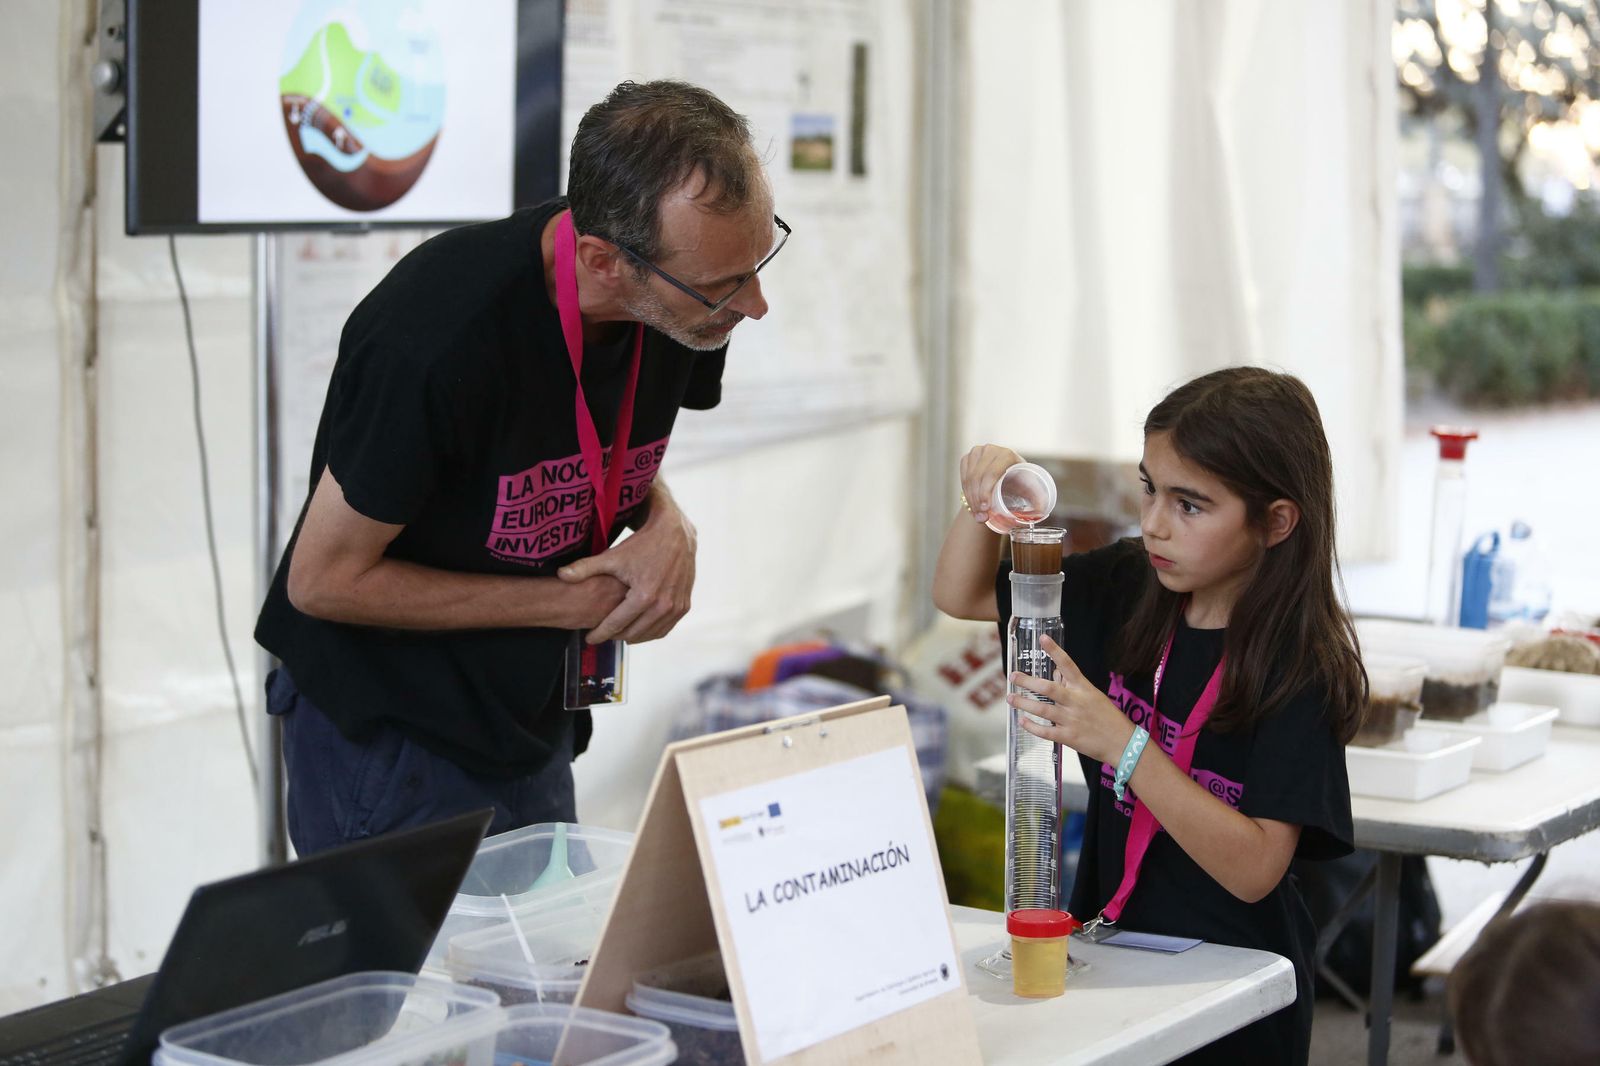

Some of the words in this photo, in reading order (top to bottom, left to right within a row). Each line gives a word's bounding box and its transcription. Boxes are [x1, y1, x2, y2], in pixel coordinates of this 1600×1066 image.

[506, 475, 534, 501] LA
[745, 890, 768, 914] LA
[773, 841, 910, 904] CONTAMINACIÓN
